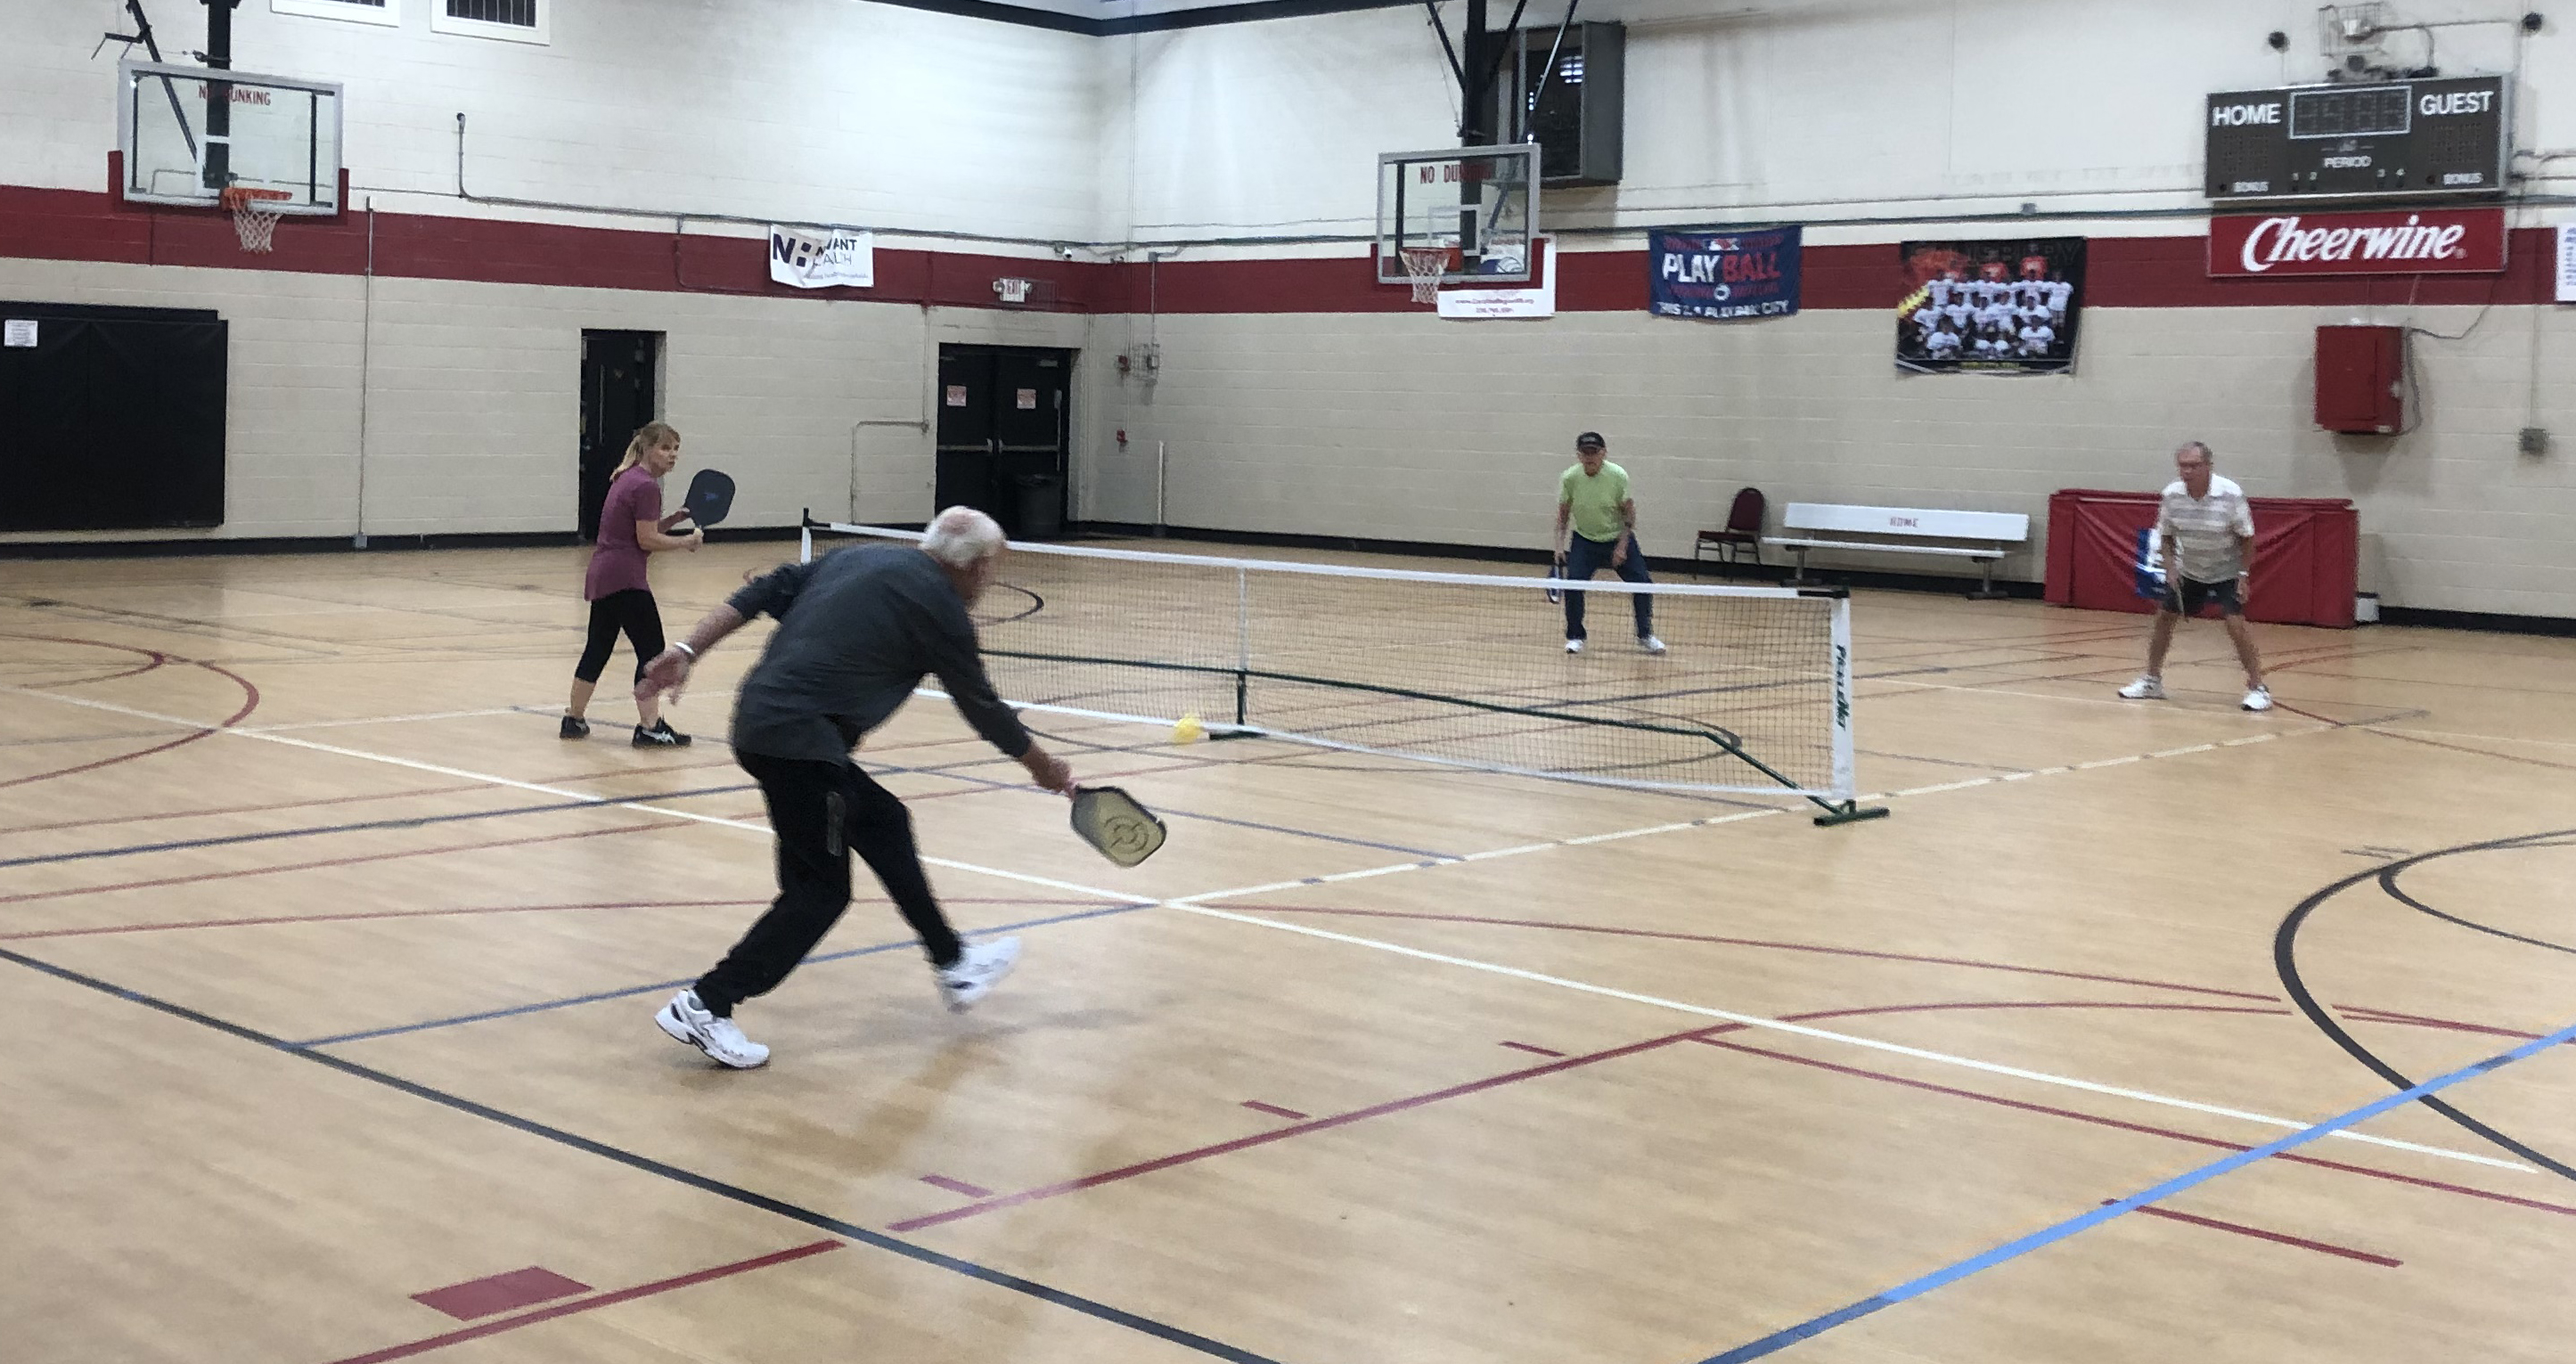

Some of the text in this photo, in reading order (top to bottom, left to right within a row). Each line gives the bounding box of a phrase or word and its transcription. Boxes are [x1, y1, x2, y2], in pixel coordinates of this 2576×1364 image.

[2212, 102, 2282, 127] HOME
[2419, 91, 2494, 117] GUEST
[2323, 155, 2372, 168] PERIOD
[1420, 166, 1435, 184] NO
[2242, 214, 2466, 273] Cheerwine
[1662, 253, 1781, 283] PLAY BALL
